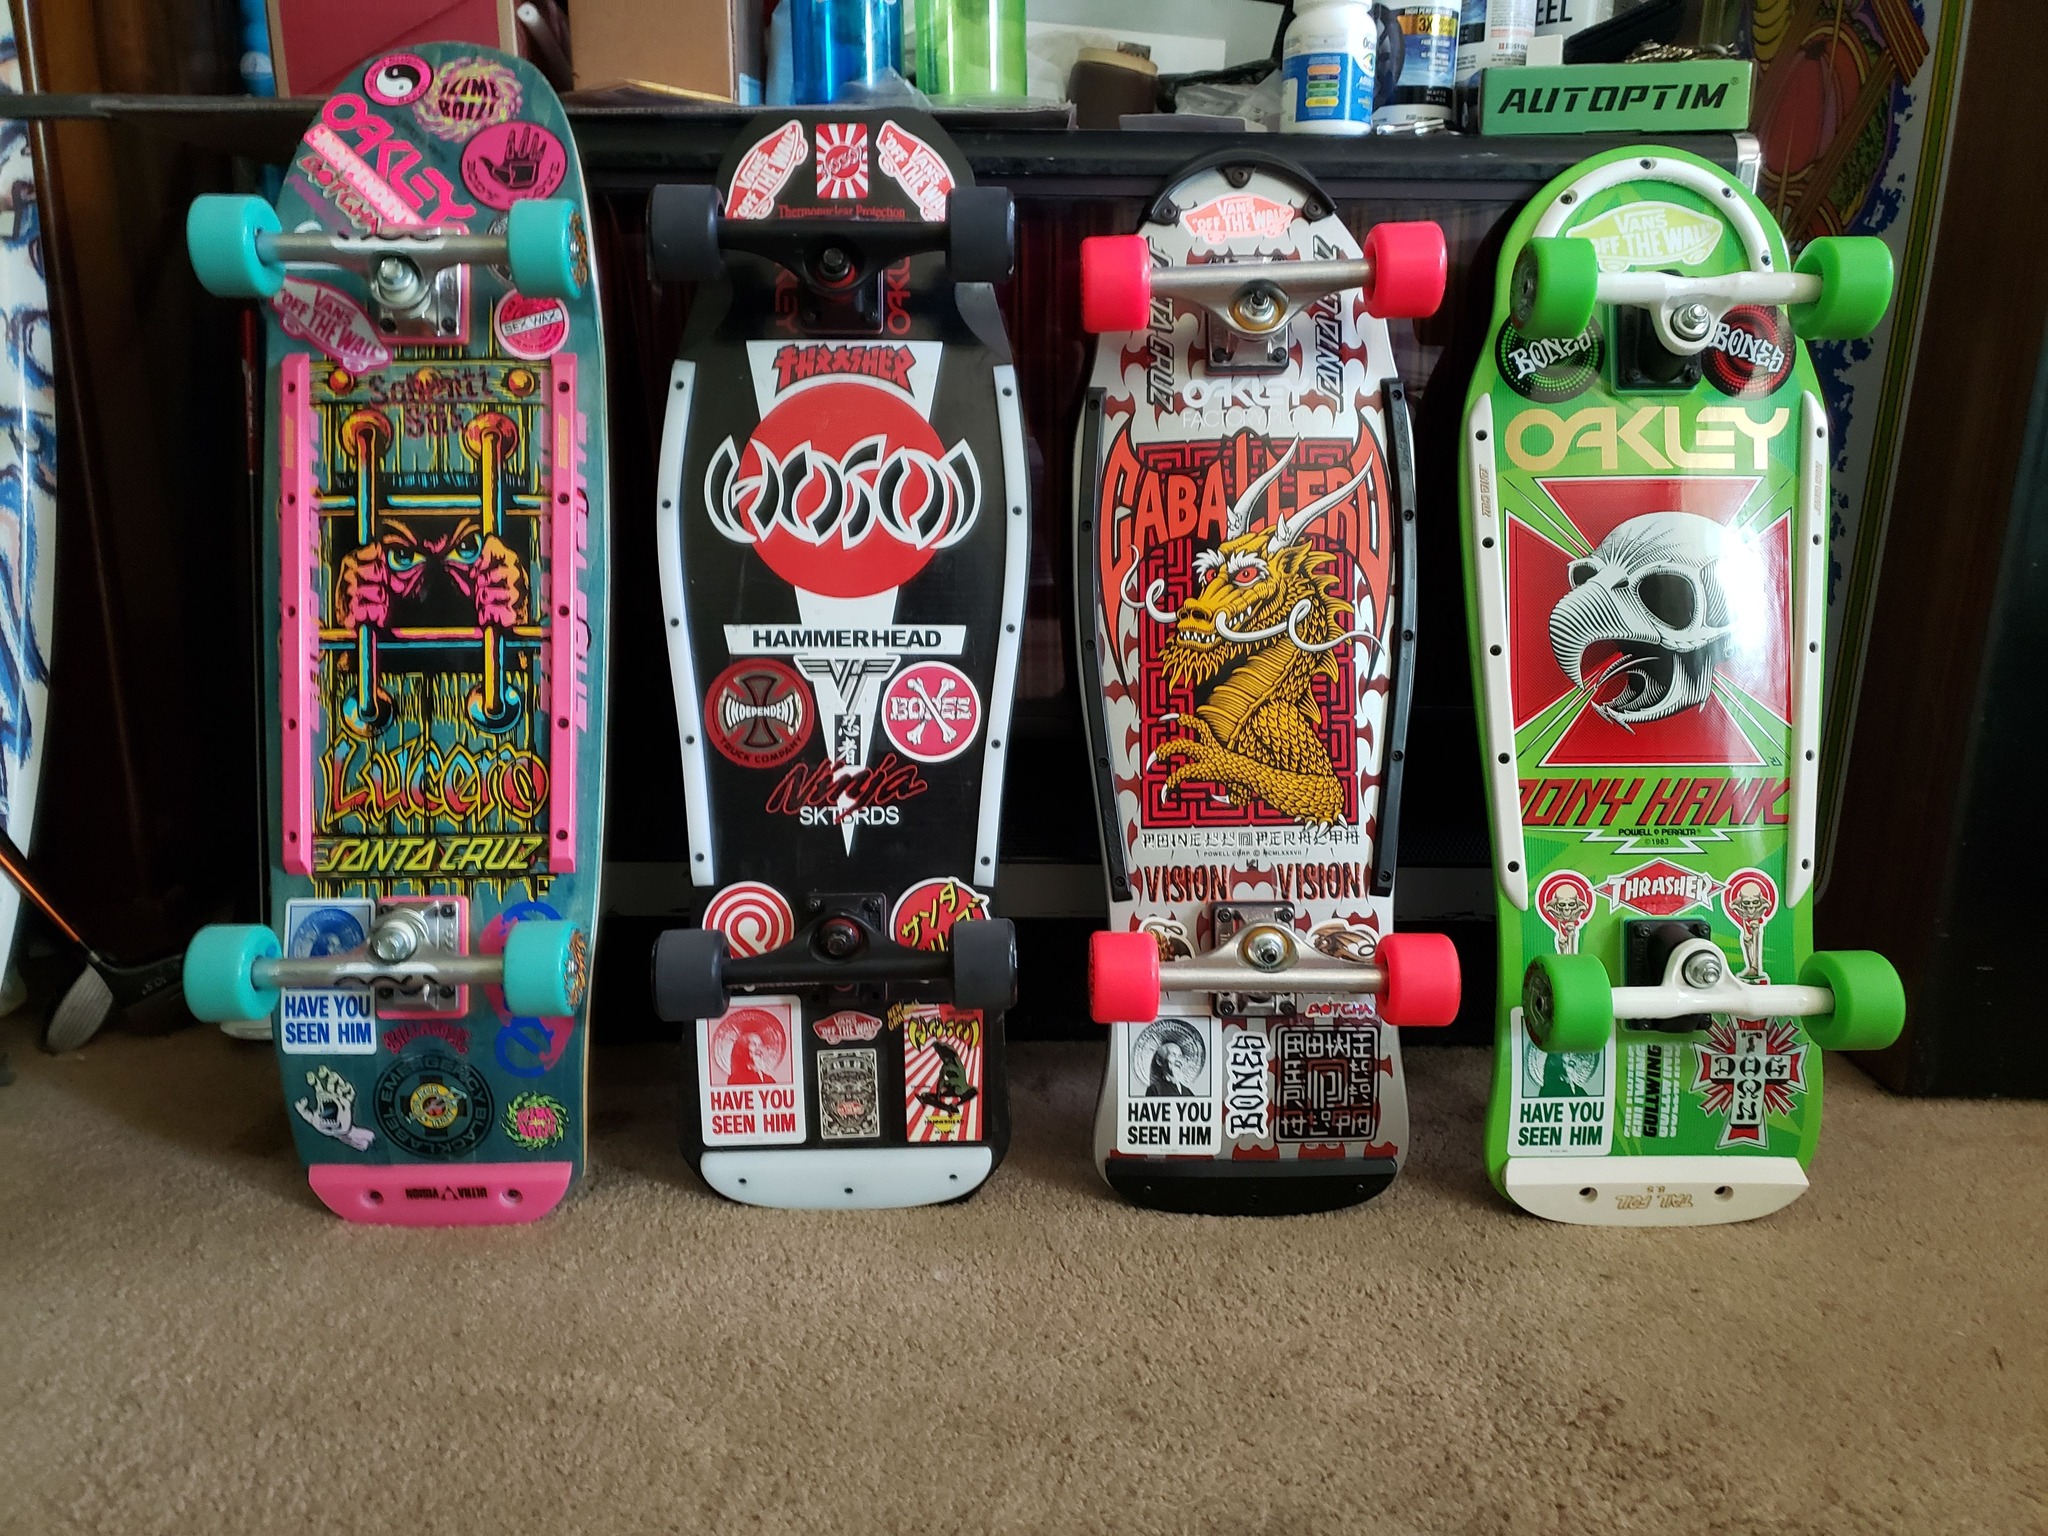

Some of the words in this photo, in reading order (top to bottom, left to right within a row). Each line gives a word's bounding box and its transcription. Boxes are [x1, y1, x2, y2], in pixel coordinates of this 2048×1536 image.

[1498, 83, 1729, 114] AUTOPTIM
[322, 93, 477, 224] OAKLEY
[736, 148, 769, 190] VANS
[909, 144, 946, 186] VANS
[751, 161, 783, 197] THE
[900, 157, 932, 205] THE
[855, 203, 906, 220] Protection
[1215, 196, 1256, 218] VANS
[1223, 210, 1252, 233] THE
[1614, 203, 1669, 235] VANS
[1622, 229, 1665, 257] THE
[314, 287, 358, 327] VANS
[308, 308, 340, 344] THE
[1711, 321, 1785, 373] BONES
[771, 344, 917, 398] THRASHER
[1147, 334, 1175, 415] CRUZ
[1315, 315, 1344, 414] SANTA
[1182, 377, 1311, 409] OAKLEY
[1182, 408, 1266, 428] FACTORY
[1504, 406, 1790, 472] OAKLEY
[725, 696, 795, 728] INDEPENDENT
[719, 737, 750, 762] TRUCK
[753, 735, 803, 763] COMPANY
[1635, 777, 1790, 826] HAWK
[1618, 828, 1653, 836] POWELL
[1661, 828, 1697, 836] PERALTA
[316, 837, 434, 872] SANTA
[439, 835, 546, 872] CRUZ
[1144, 863, 1228, 903] VISION
[1276, 862, 1361, 901] VISION
[1608, 873, 1714, 911] THRASHER
[285, 996, 330, 1018] HAVE
[336, 995, 371, 1017] YOU
[285, 1022, 329, 1044] SEEN
[338, 1022, 372, 1044] HIM
[838, 1023, 856, 1037] THE
[1713, 1055, 1788, 1078] DOG
[710, 1091, 754, 1111] HAVE
[758, 1089, 795, 1110] YOU
[1230, 1035, 1266, 1134] BONES
[1643, 1044, 1662, 1138] GULLWING
[711, 1115, 756, 1136] SEEN
[762, 1113, 796, 1133] HIM
[1127, 1103, 1171, 1122] HAVE
[1177, 1102, 1212, 1122] YOU
[1520, 1103, 1564, 1123] HAVE
[1568, 1102, 1604, 1123] YOU
[1127, 1126, 1171, 1146] SEEN
[1179, 1126, 1212, 1146] HIM
[1517, 1126, 1562, 1147] SEEN
[1569, 1125, 1603, 1146] HIM
